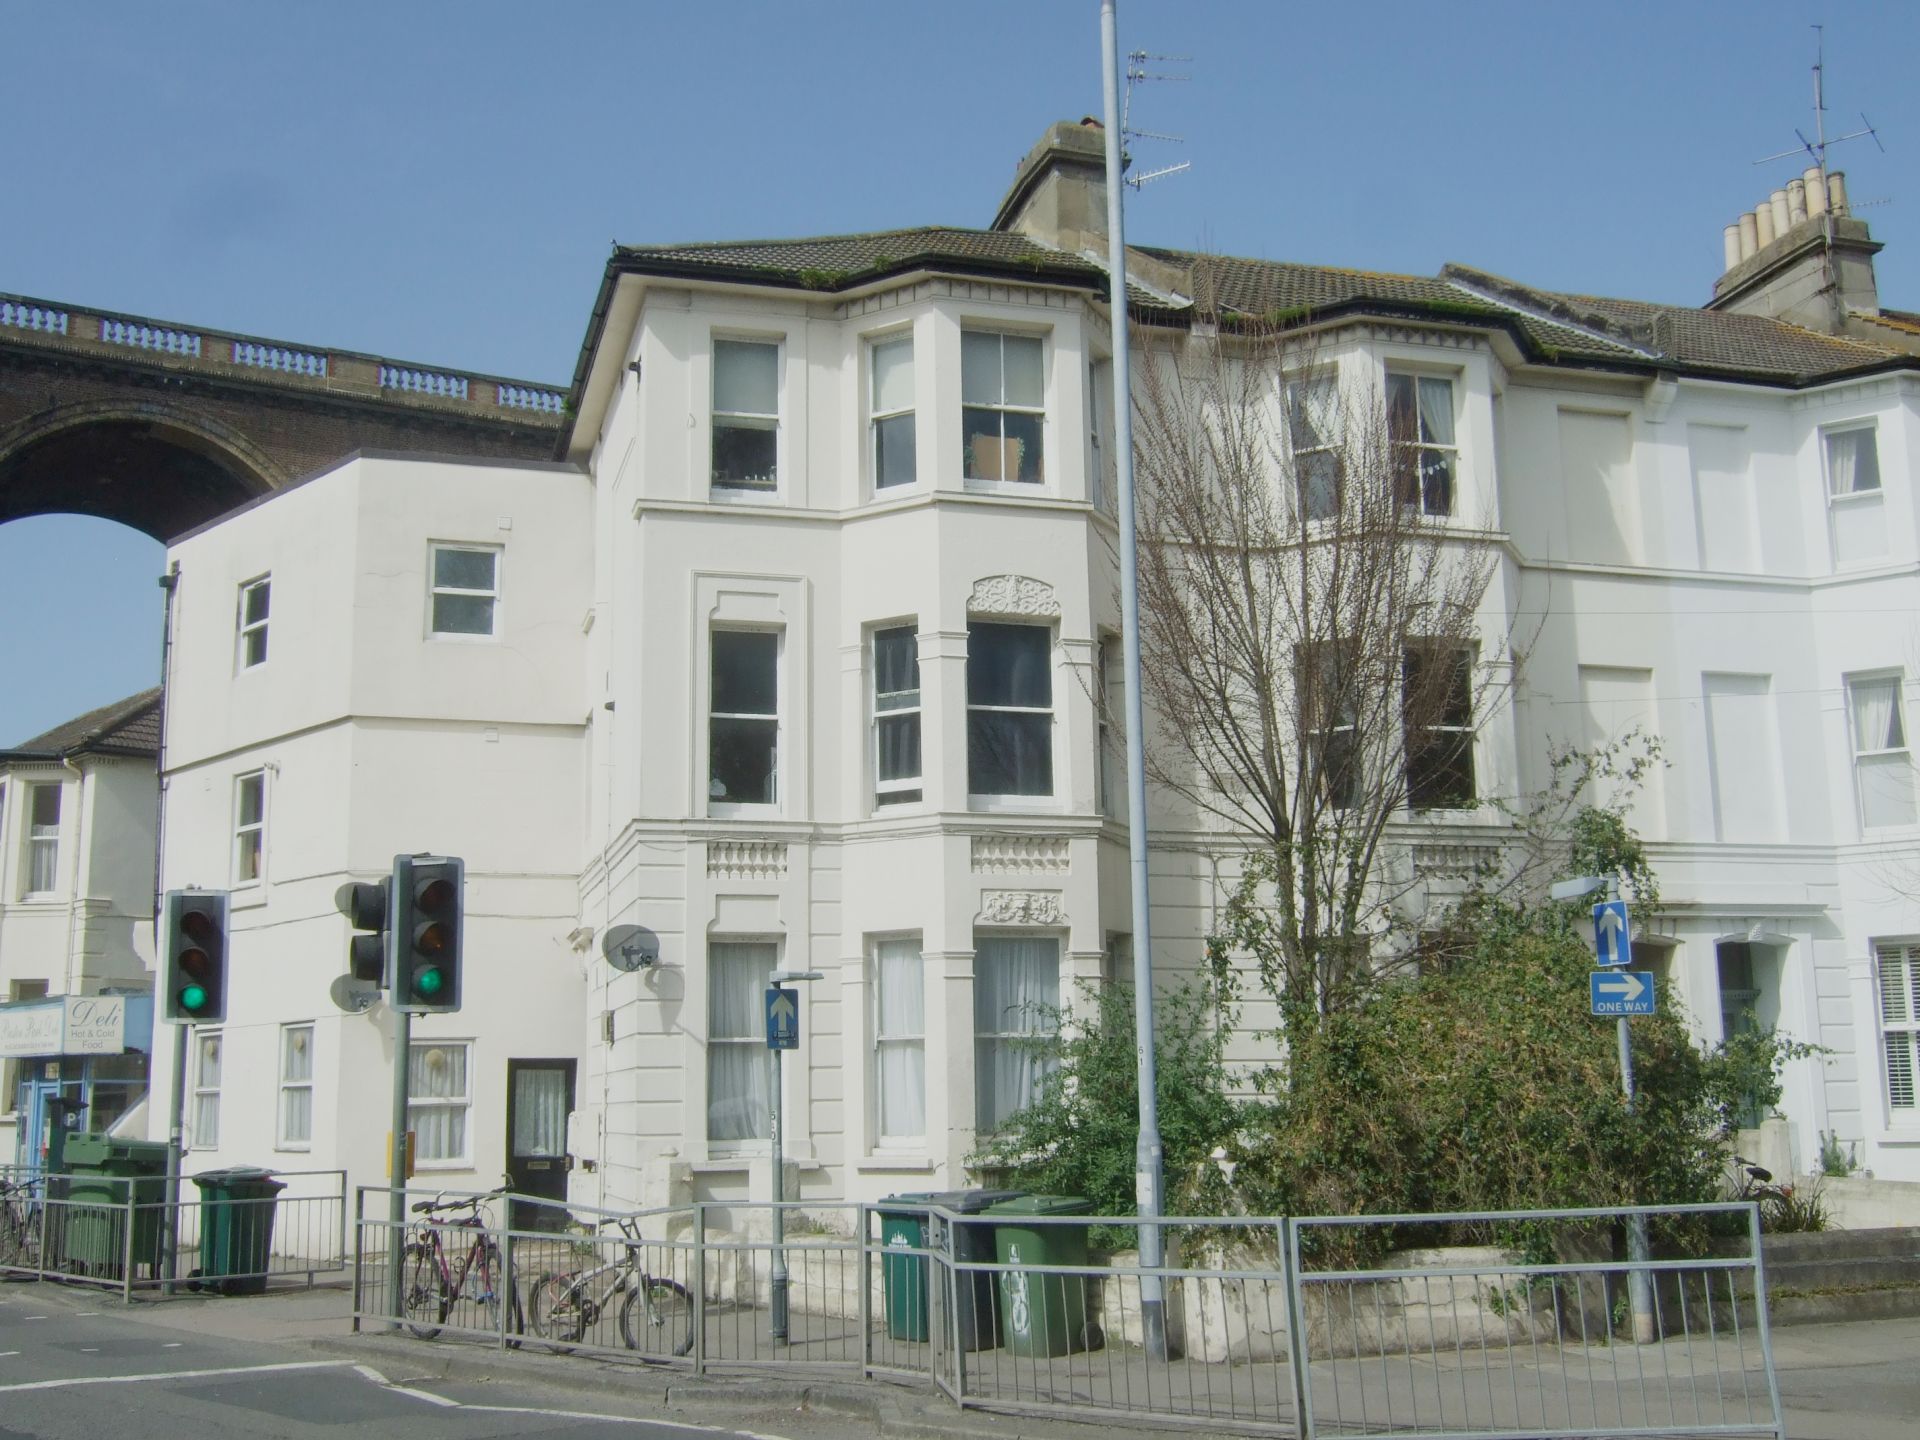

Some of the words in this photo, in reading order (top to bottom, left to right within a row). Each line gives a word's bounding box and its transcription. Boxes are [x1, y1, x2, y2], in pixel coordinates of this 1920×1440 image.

[1597, 1002, 1622, 1012] ONE
[1623, 1002, 1648, 1012] WAY
[70, 1000, 122, 1028] Deli
[71, 1030, 86, 1038] Hot
[87, 1029, 94, 1038] &
[96, 1029, 115, 1038] Cold
[82, 1040, 103, 1049] Food
[67, 1112, 76, 1127] P
